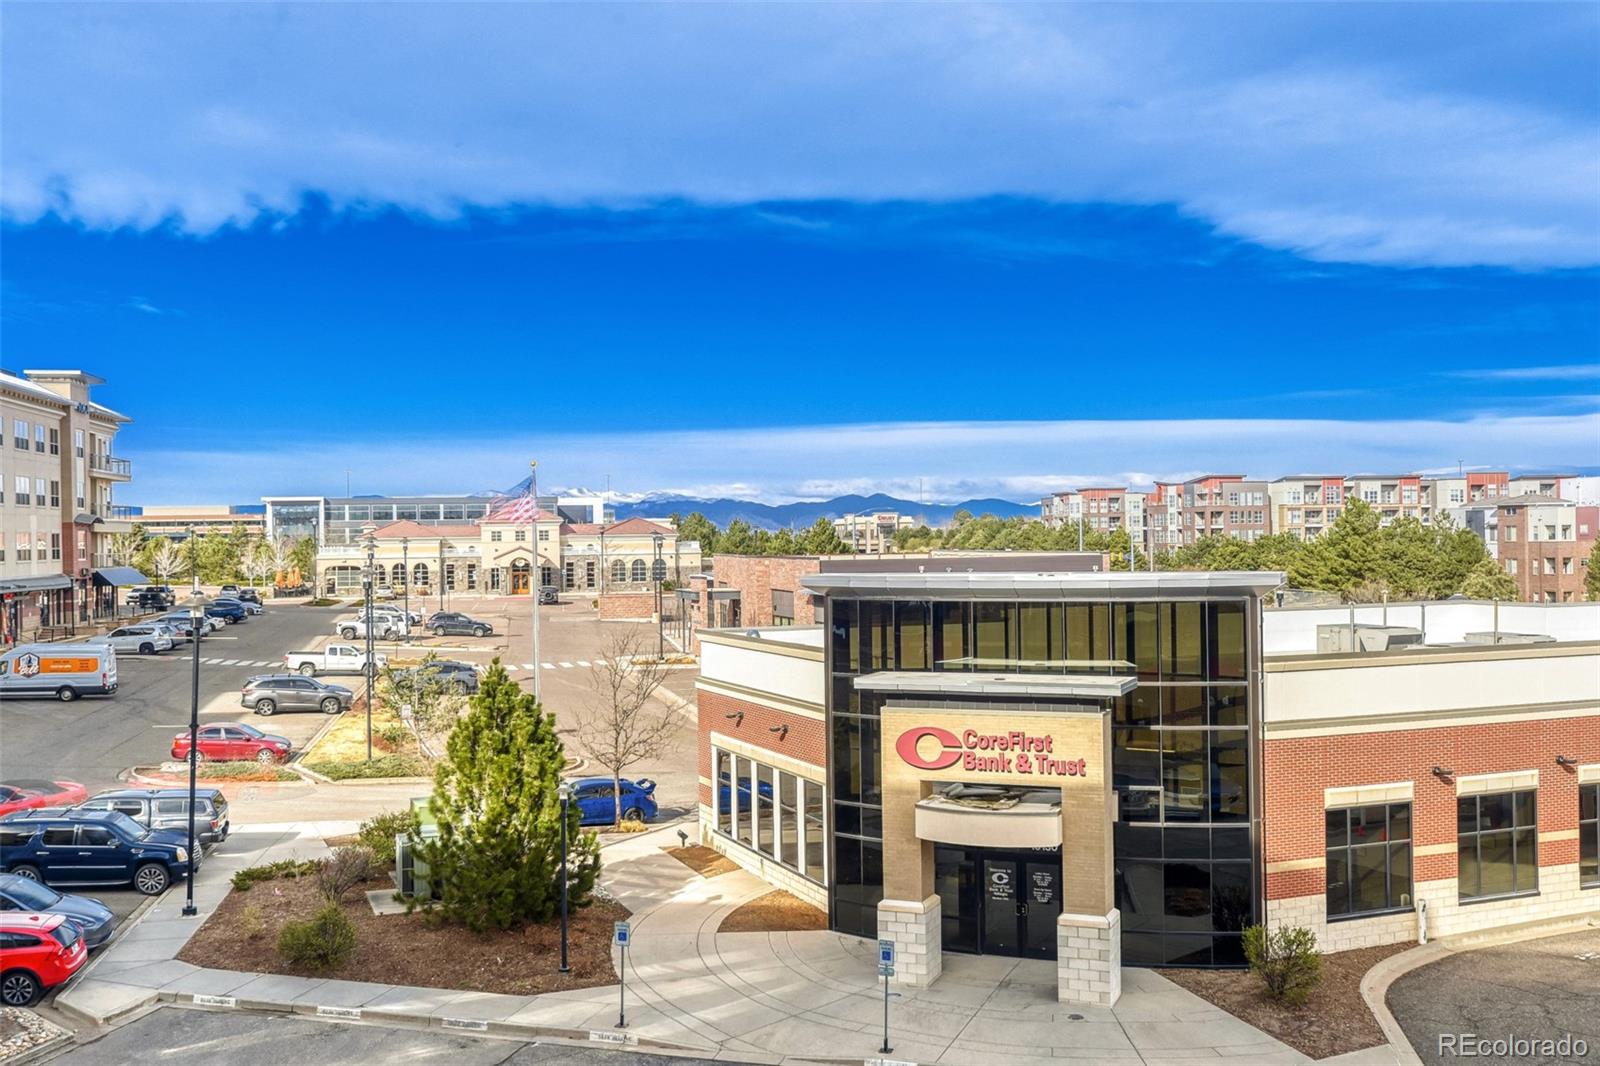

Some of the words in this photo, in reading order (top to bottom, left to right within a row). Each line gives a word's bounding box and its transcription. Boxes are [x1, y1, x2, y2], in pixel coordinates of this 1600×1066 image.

[963, 729, 1053, 752] CoreFirst
[963, 751, 1012, 772] Bank
[1015, 754, 1032, 774] &
[1034, 754, 1087, 777] Trust
